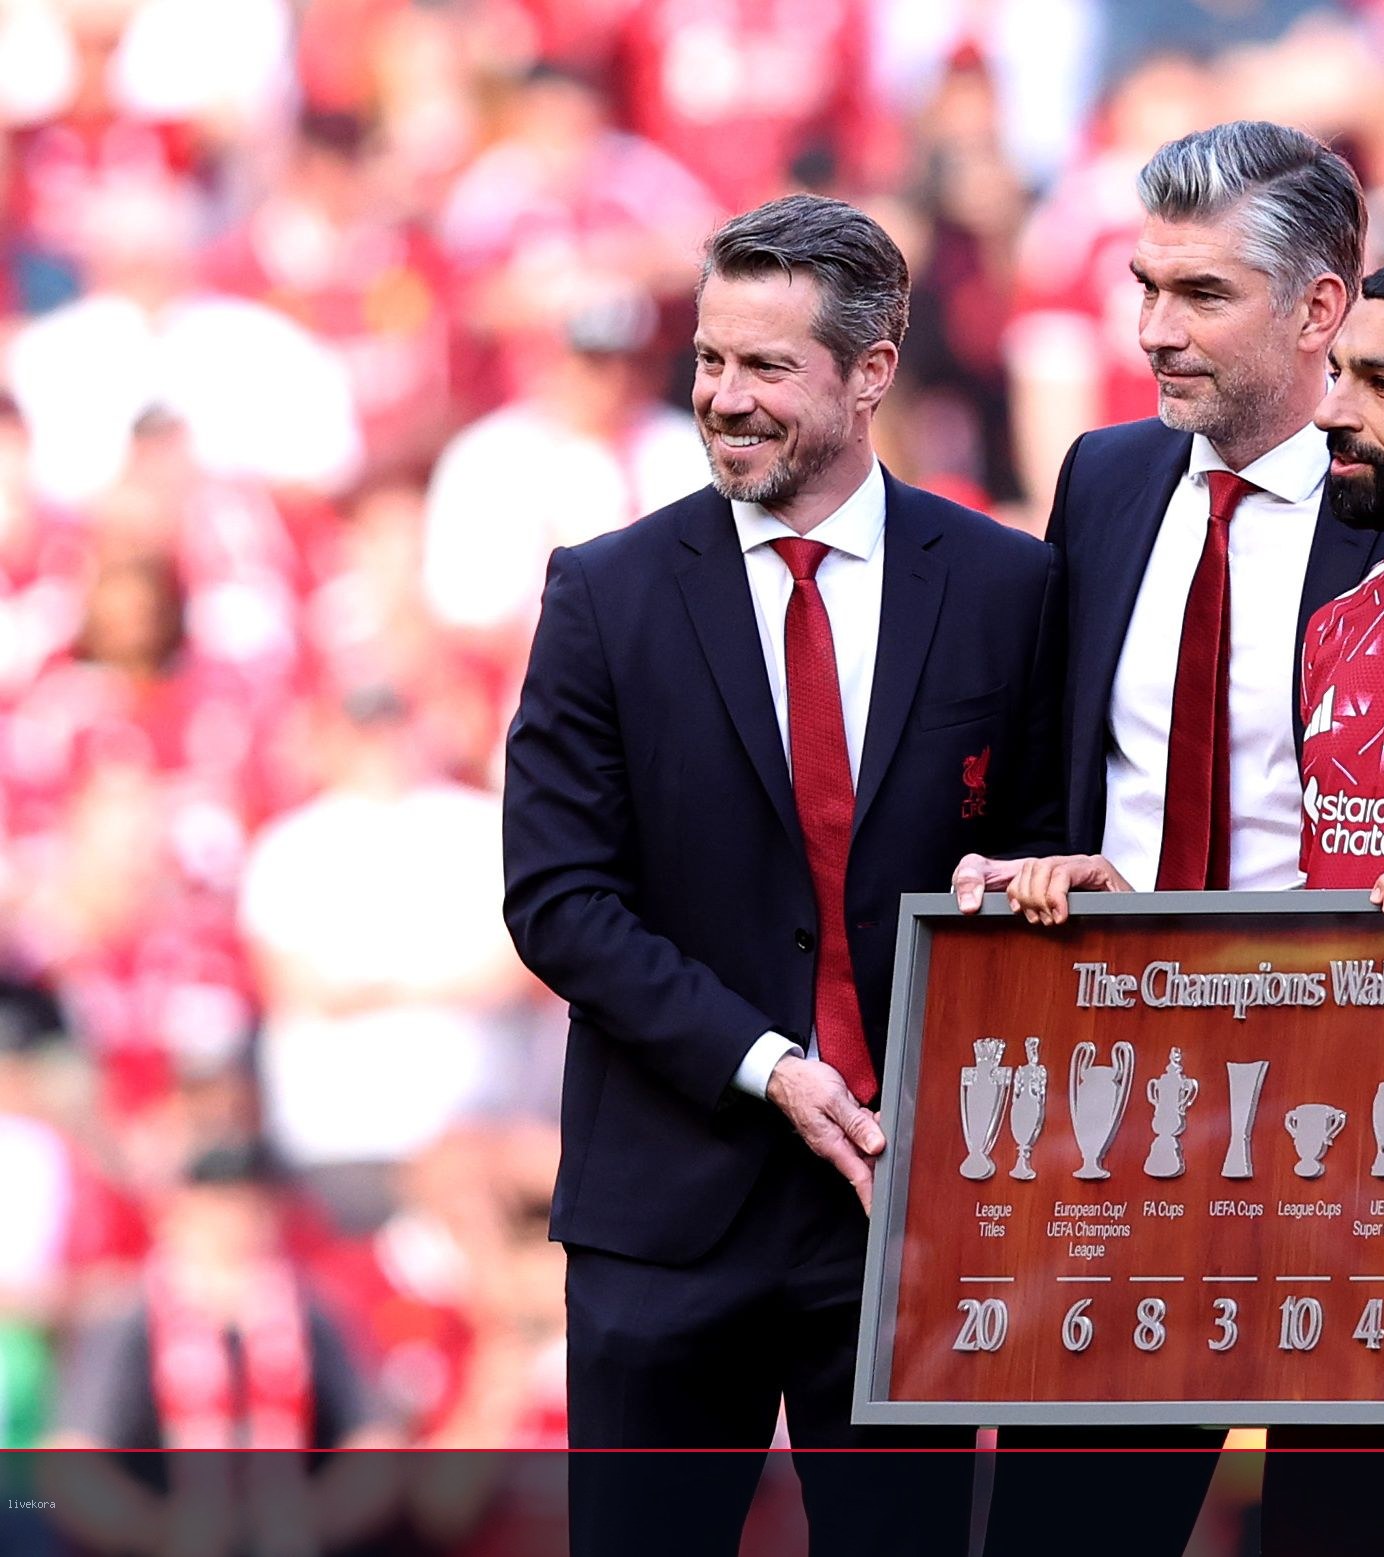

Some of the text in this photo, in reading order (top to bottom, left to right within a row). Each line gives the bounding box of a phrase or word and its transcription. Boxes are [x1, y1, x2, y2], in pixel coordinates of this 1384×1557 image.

[1073, 961, 1138, 1008] The
[1140, 960, 1327, 1019] Champions
[975, 1201, 1012, 1219] League
[1054, 1201, 1127, 1219] European Cup/
[1143, 1201, 1184, 1220] FA Cups
[1209, 1201, 1264, 1219] UEFA Cups
[1278, 1201, 1342, 1219] League Cups
[979, 1222, 1005, 1237] Titles
[1047, 1220, 1130, 1239] UEFA Champions
[1353, 1221, 1383, 1239] Super
[1069, 1242, 1105, 1260] League
[952, 1298, 1008, 1351] 20
[1061, 1298, 1093, 1351] 6
[1133, 1298, 1166, 1351] 8
[1208, 1298, 1239, 1351] 3
[1278, 1295, 1323, 1351] 10
